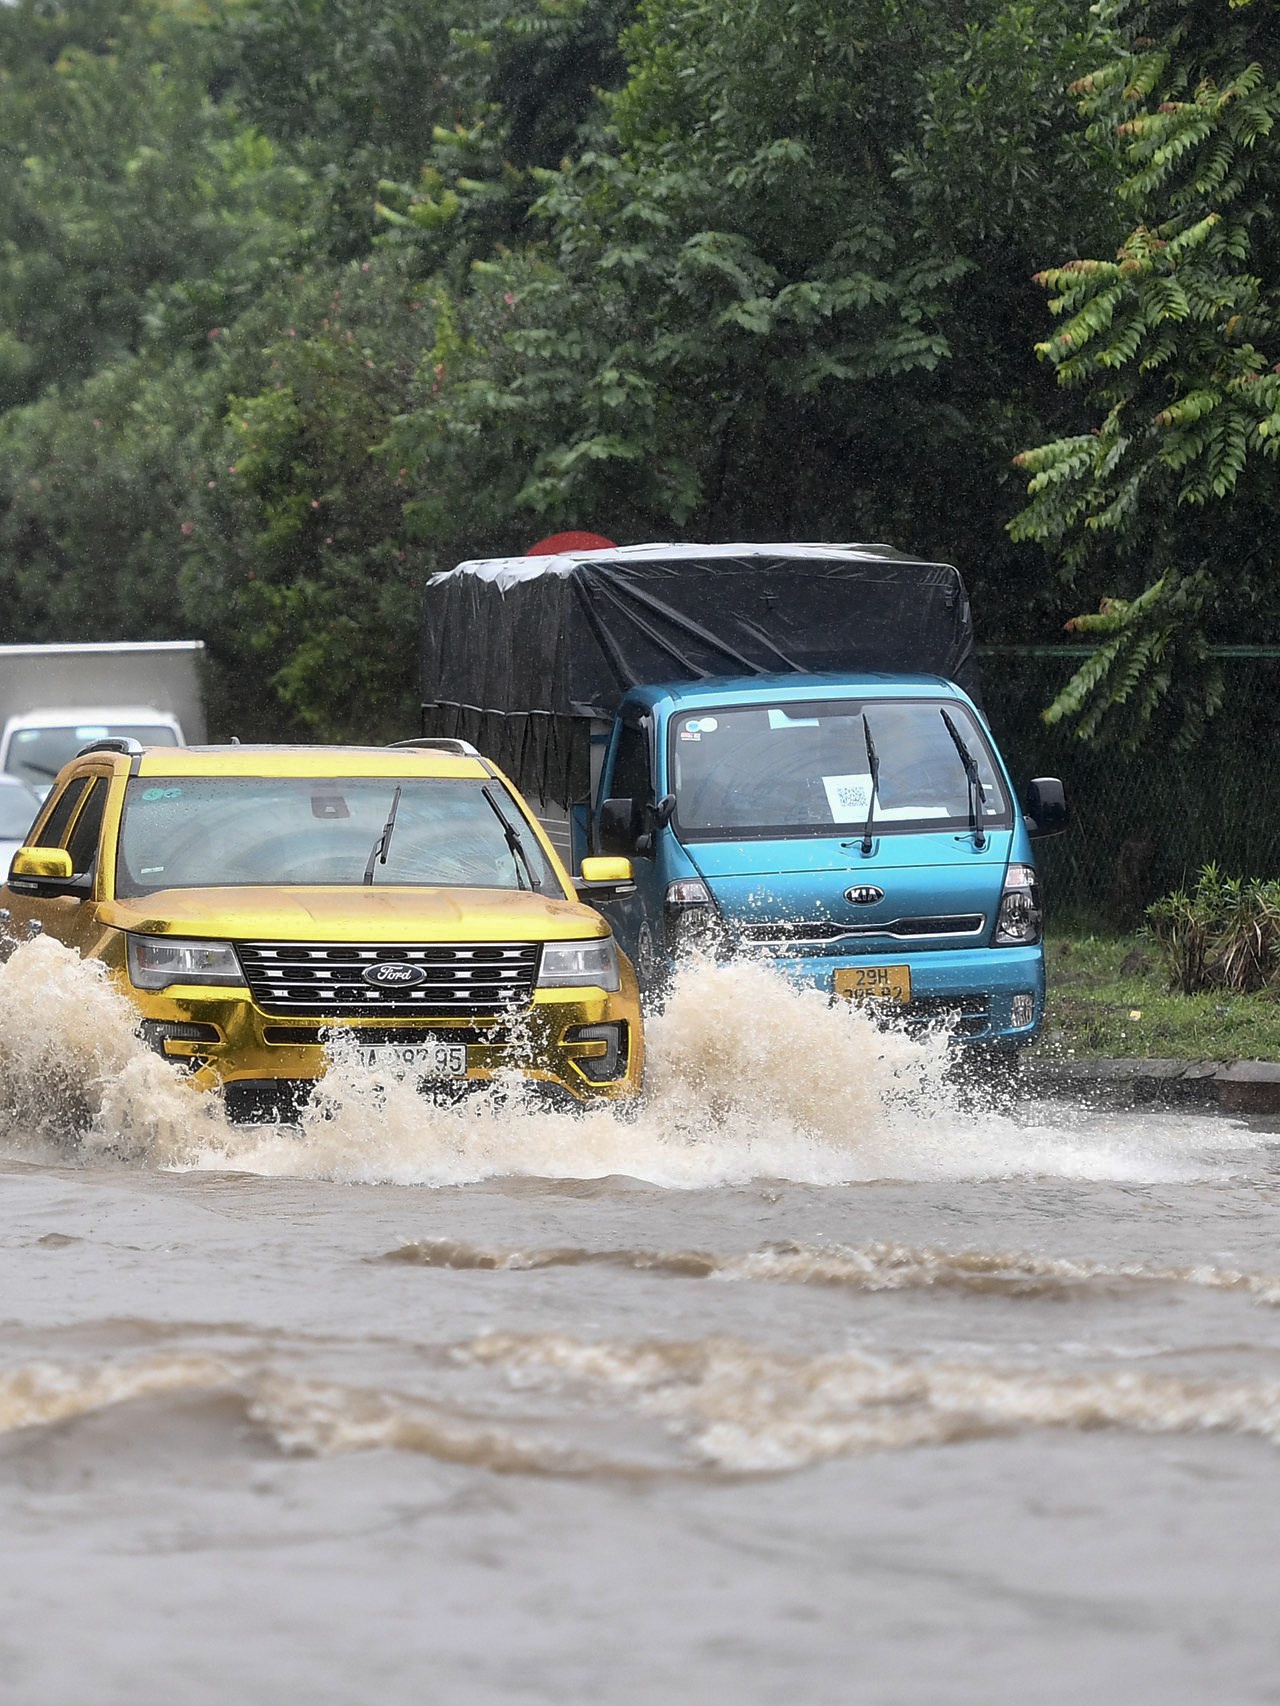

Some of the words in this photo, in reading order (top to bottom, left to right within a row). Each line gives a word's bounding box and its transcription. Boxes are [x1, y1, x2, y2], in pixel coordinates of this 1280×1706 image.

[850, 888, 878, 901] KIA
[377, 965, 412, 980] Ford
[856, 968, 888, 986] 29H
